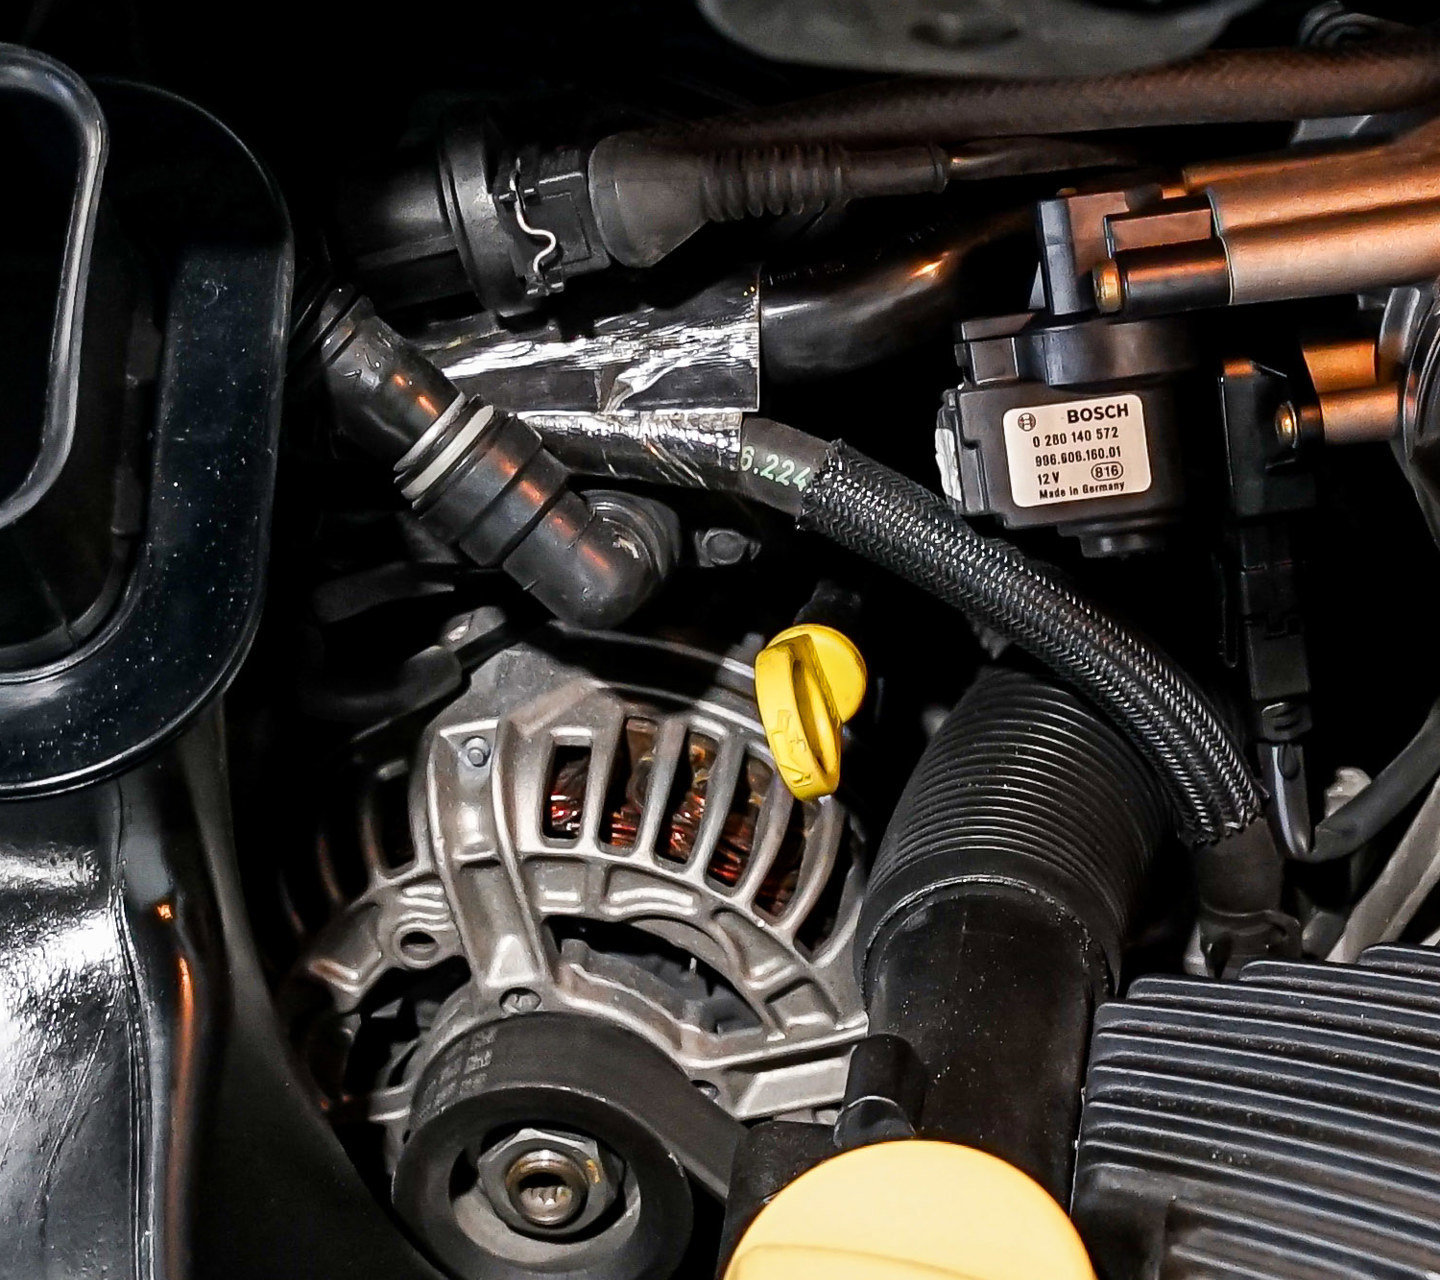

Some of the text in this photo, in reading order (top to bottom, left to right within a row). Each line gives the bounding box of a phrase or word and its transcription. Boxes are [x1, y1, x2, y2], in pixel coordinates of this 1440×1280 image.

[1066, 403, 1129, 424] BOSCH
[1032, 426, 1119, 448] 0 280 140 572
[1037, 465, 1120, 486] 12 V 816
[1039, 481, 1125, 500] Made in Germany
